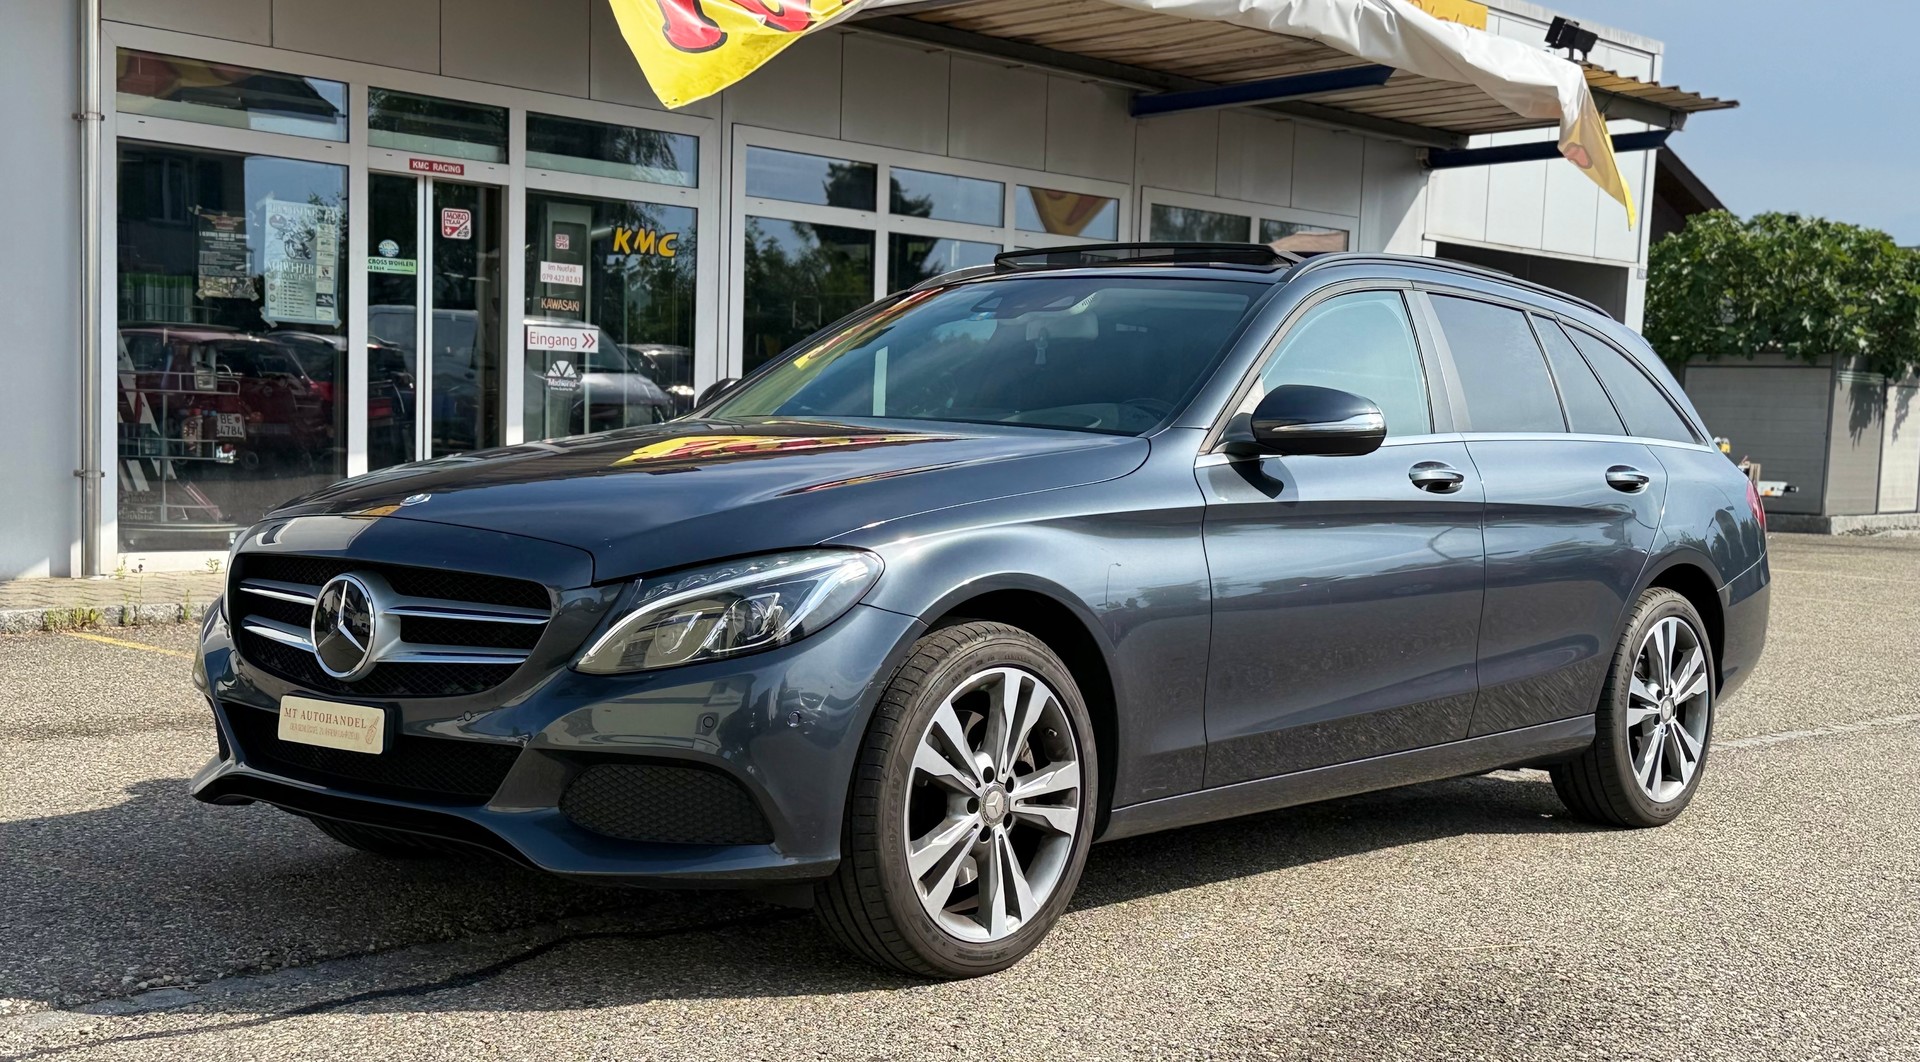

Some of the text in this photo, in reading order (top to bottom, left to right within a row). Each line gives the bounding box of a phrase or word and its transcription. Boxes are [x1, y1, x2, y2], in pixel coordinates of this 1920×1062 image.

[412, 160, 462, 174] KMC RACING
[612, 226, 680, 258] KMC
[541, 298, 580, 312] KAWASAKI
[529, 331, 577, 349] Eingang
[220, 414, 233, 425] BE
[284, 707, 367, 729] MT AUTOHANDEL
